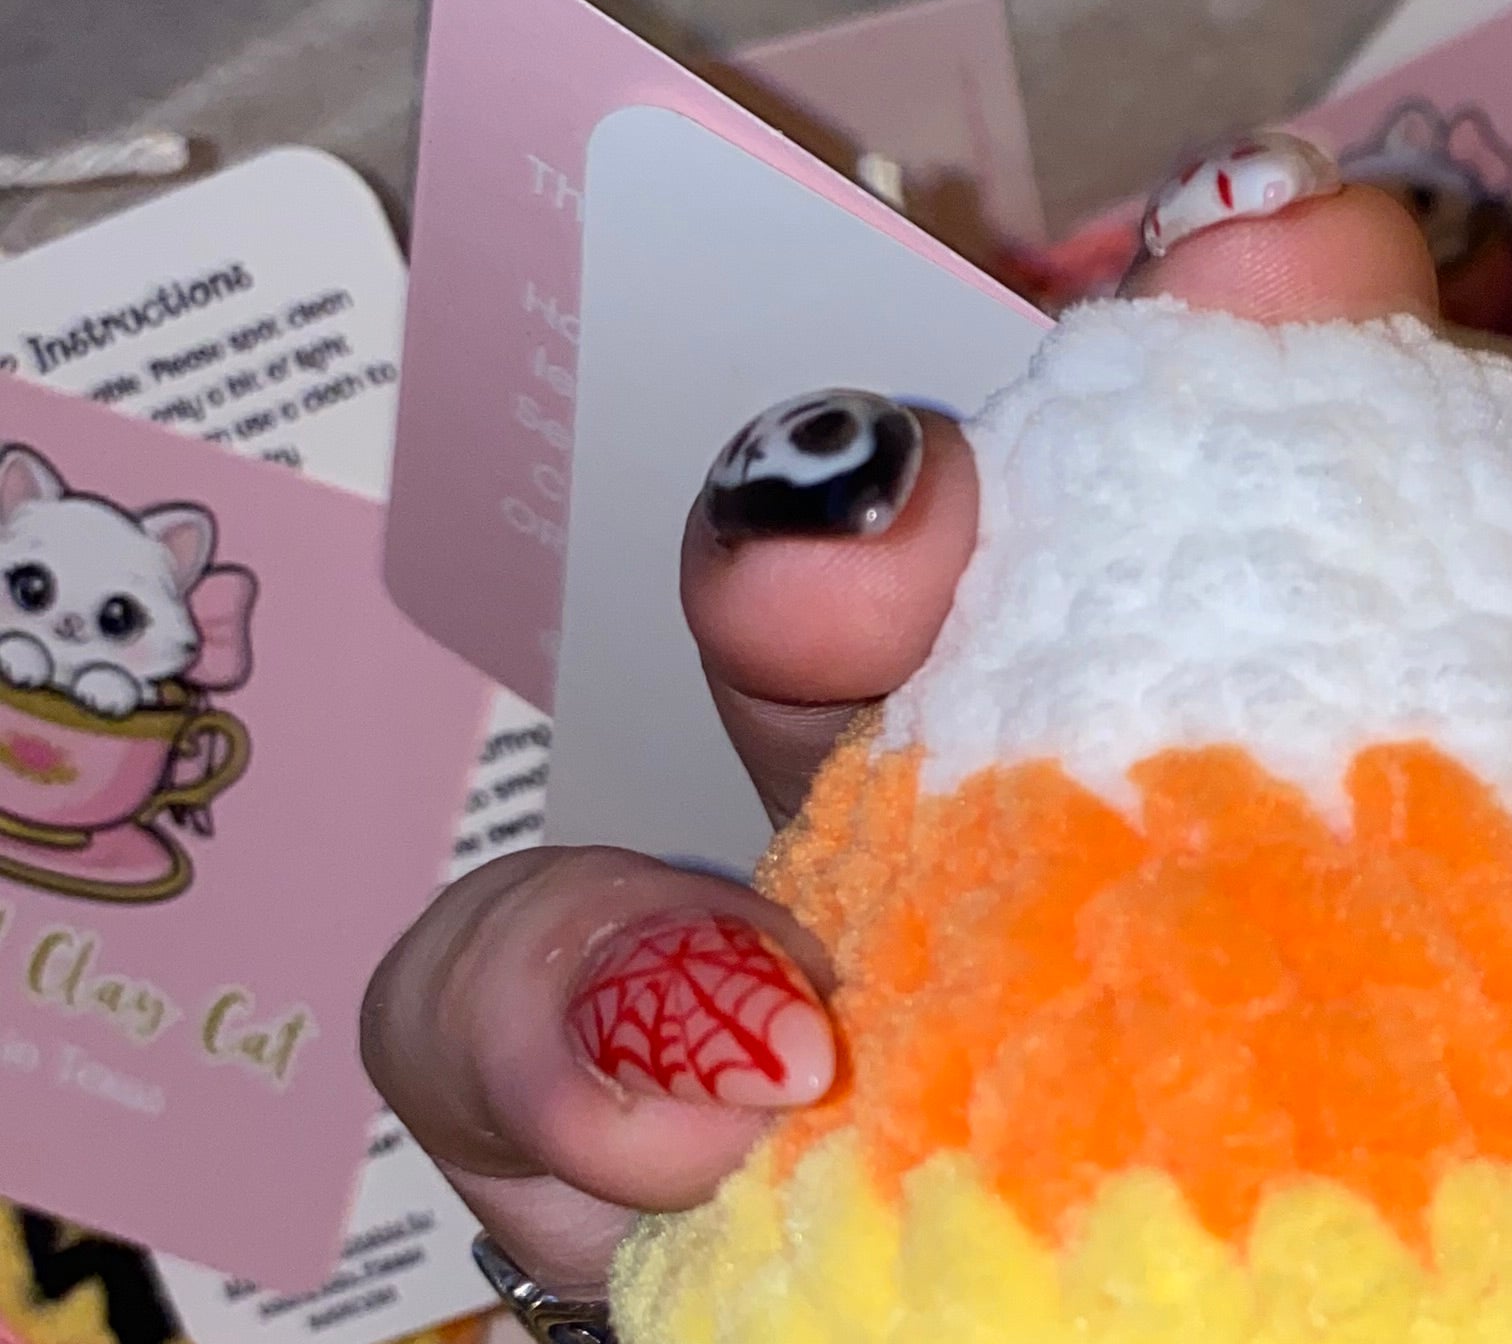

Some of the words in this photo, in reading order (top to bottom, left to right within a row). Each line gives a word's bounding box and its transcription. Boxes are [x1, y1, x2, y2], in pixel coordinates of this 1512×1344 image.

[25, 260, 254, 376] Instructions
[148, 341, 224, 384] Please
[287, 289, 354, 329] clean
[25, 928, 172, 1044] Clay
[202, 990, 307, 1081] Cat
